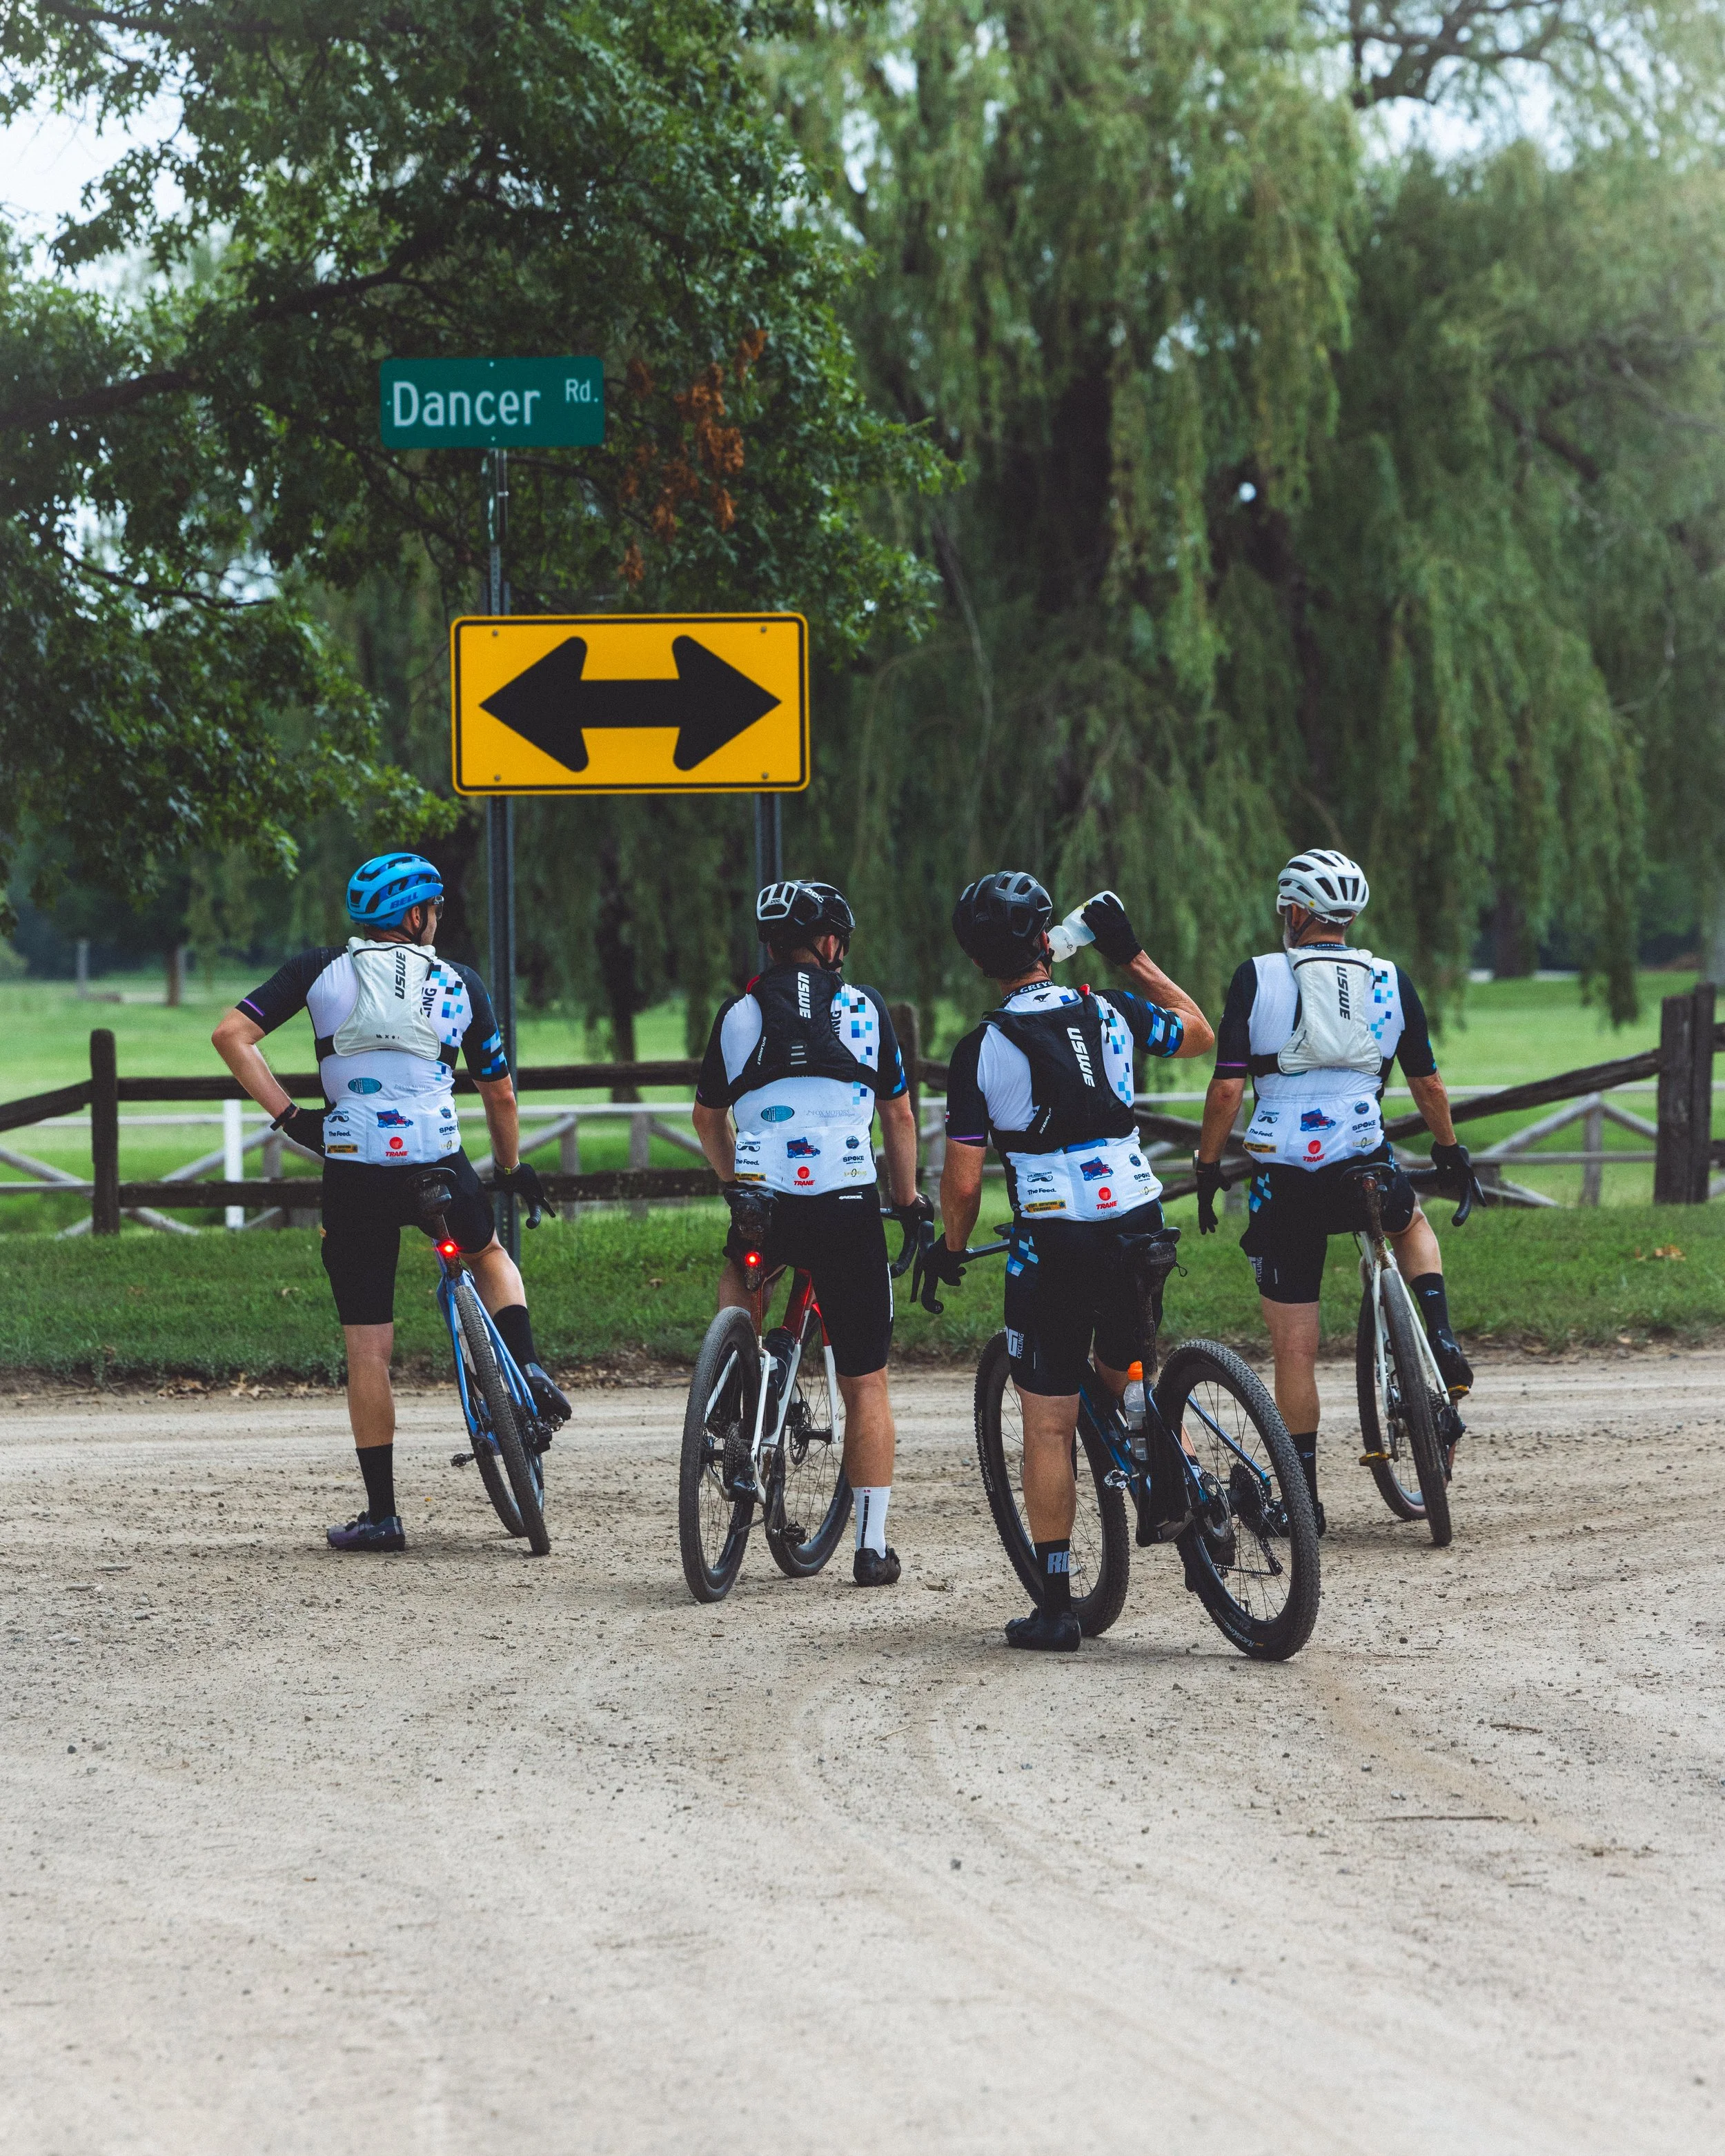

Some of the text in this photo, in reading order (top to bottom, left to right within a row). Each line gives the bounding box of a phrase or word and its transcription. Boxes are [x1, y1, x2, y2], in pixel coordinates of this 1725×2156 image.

[393, 378, 599, 426] Dancer Rd.
[390, 892, 418, 909] BELL
[805, 888, 824, 903] POC
[395, 951, 406, 1000] USWE
[797, 971, 811, 1019] USWE
[1337, 965, 1350, 1020] USWE
[1067, 1027, 1095, 1088] USWE
[1352, 1119, 1376, 1131] SPOKE
[1303, 1153, 1326, 1163] TRANE
[1134, 1172, 1151, 1180] SPOKE
[1096, 1200, 1118, 1209] TRANE
[1016, 1333, 1025, 1359] CYCLING
[978, 1409, 993, 1492] CONTINENTAL
